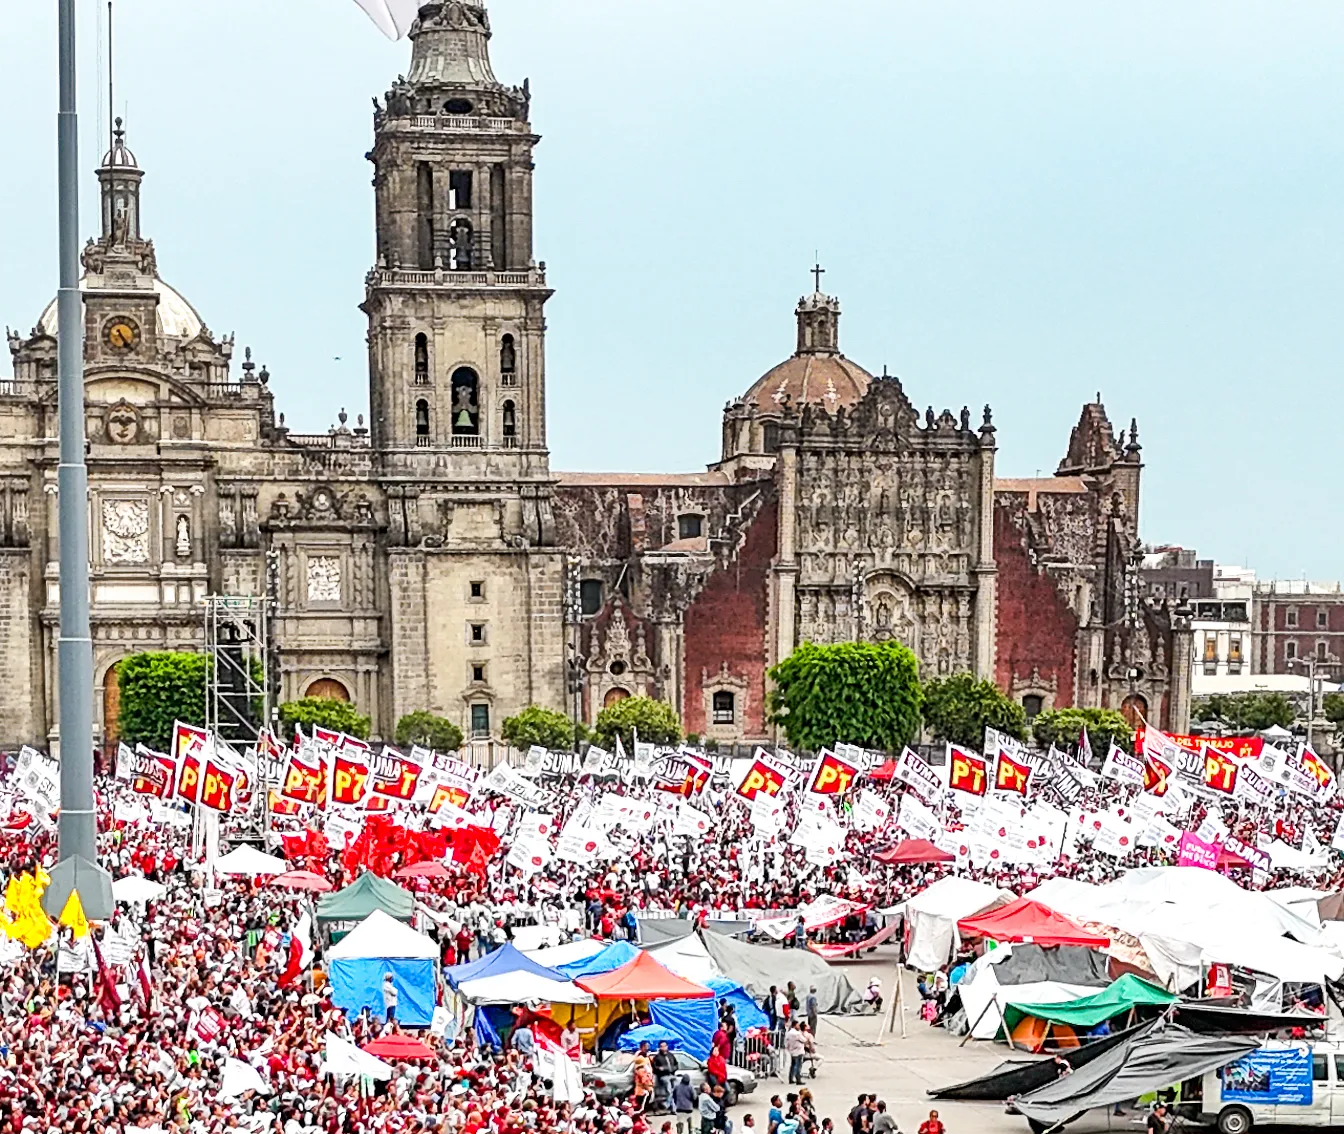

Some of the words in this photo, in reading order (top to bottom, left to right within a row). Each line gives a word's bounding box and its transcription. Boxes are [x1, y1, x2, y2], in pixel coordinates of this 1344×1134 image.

[434, 754, 480, 784] SUMA
[542, 752, 582, 774] SUMA
[906, 753, 941, 790] SUMA
[952, 761, 984, 791] PT
[997, 760, 1027, 791] PT
[1206, 761, 1238, 790] PT
[203, 776, 228, 810] PT
[815, 764, 852, 794] PT
[1225, 837, 1270, 872] SUMA
